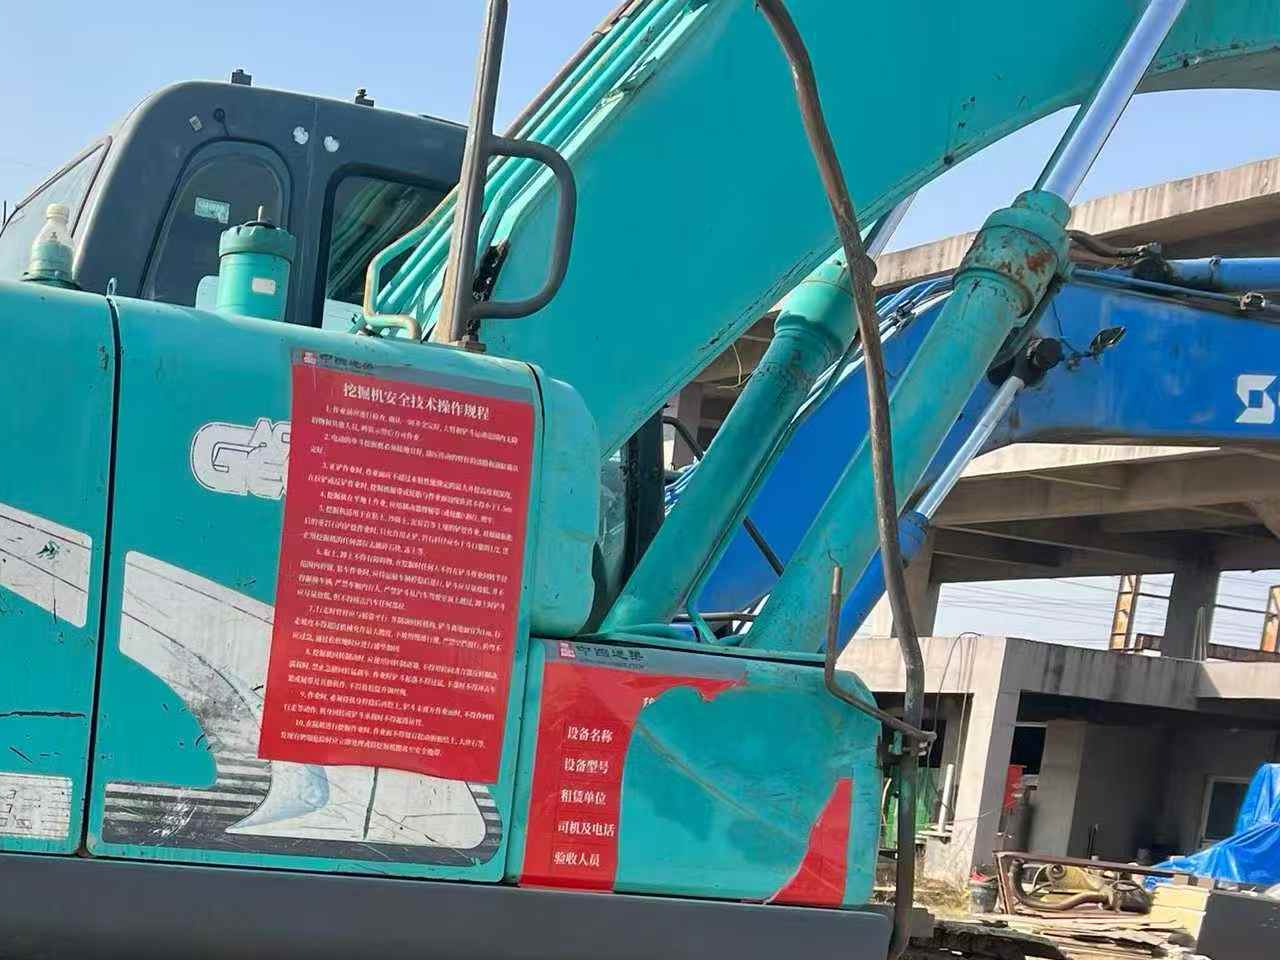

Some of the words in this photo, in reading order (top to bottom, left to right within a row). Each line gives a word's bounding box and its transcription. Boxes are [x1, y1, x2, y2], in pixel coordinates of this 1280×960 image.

[342, 381, 491, 421] 挖掘机安全技术操作规程
[1235, 374, 1280, 424] S
[567, 725, 613, 744] 设备名称
[564, 757, 609, 775] 设备型号
[560, 788, 607, 806] 租赁单位
[557, 819, 616, 837] 司机及电话
[553, 850, 600, 867] 验收人员
